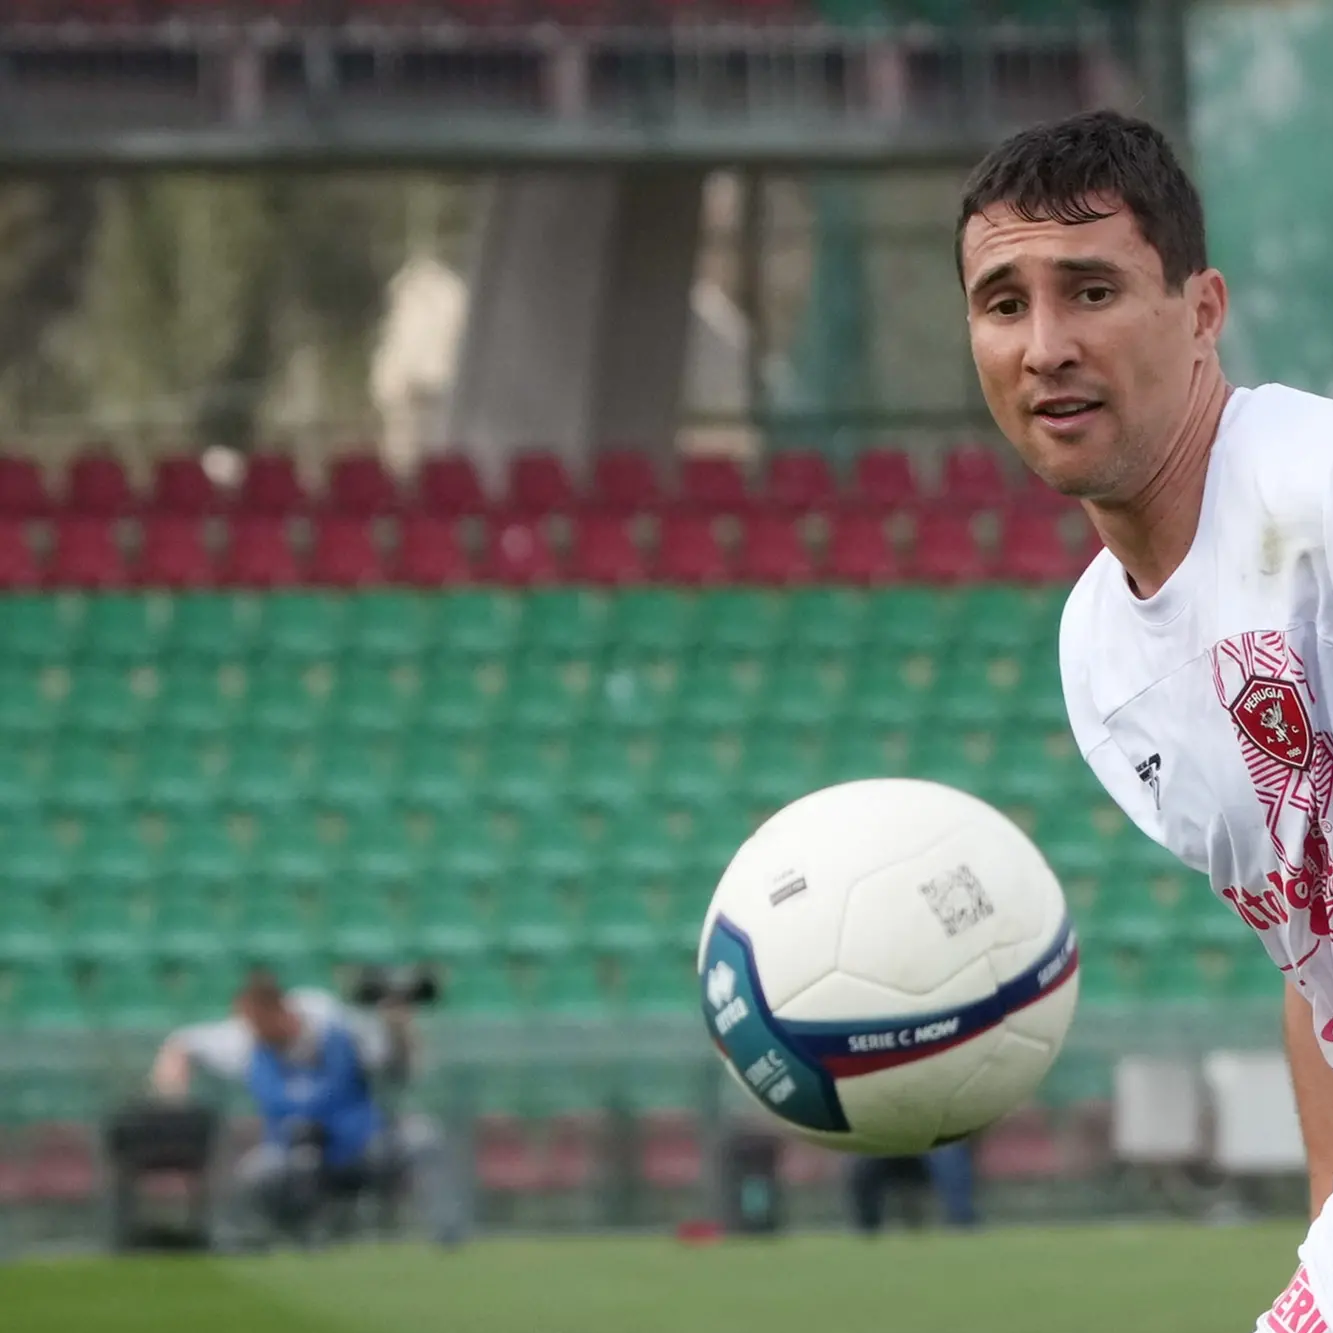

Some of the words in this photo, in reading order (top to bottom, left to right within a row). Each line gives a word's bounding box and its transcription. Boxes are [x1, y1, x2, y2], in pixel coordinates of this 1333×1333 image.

[1243, 687, 1285, 713] PERUGIA
[848, 1029, 895, 1053] SERIE
[898, 1028, 912, 1046] C
[915, 1016, 961, 1043] NOW
